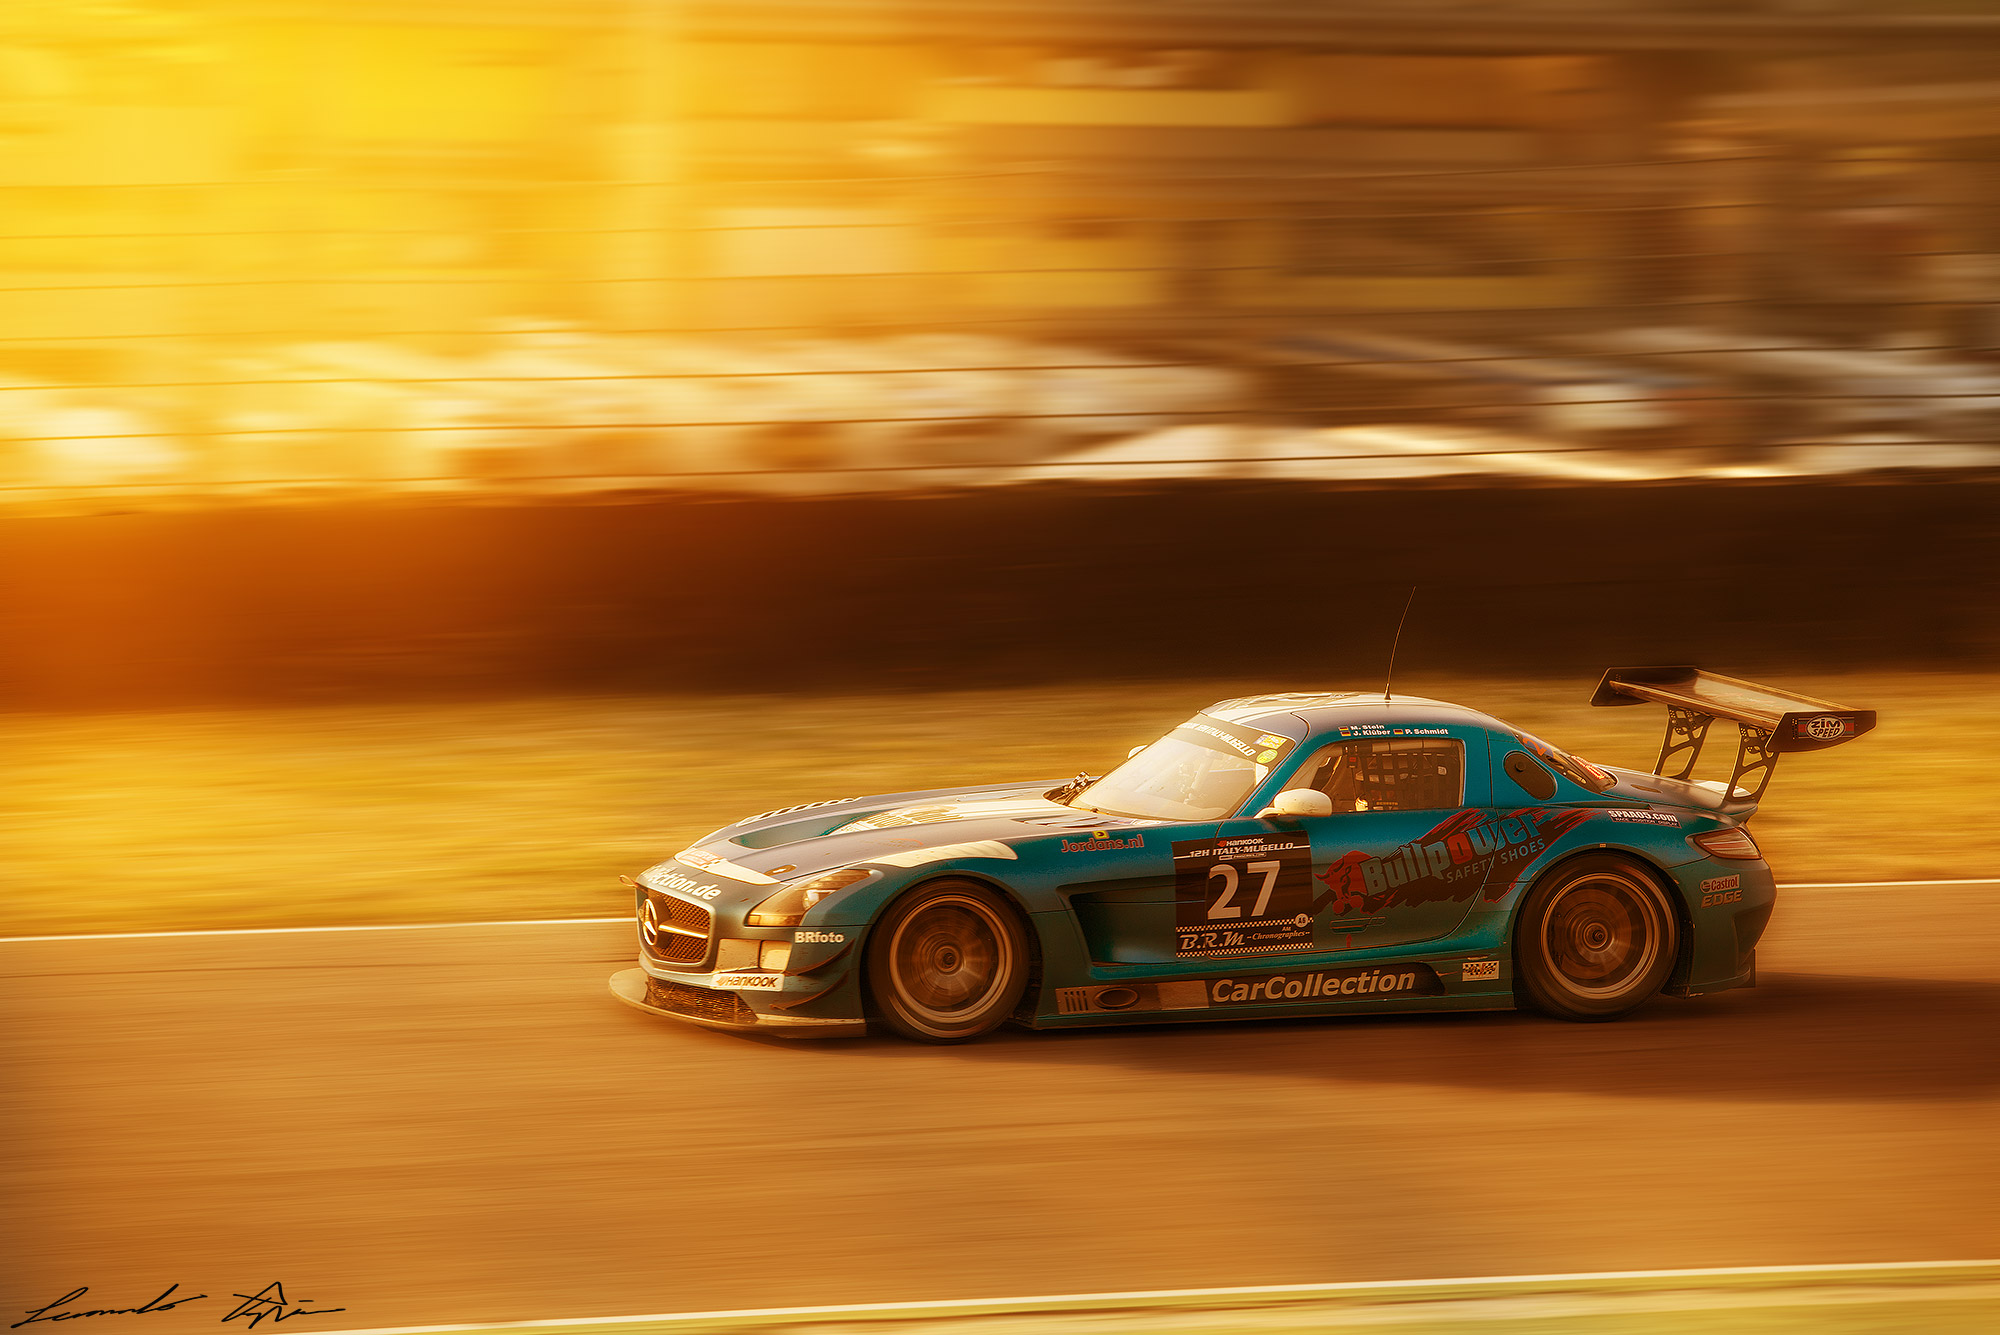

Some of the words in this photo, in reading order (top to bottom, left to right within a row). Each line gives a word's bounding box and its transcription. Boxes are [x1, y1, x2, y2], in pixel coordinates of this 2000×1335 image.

[1812, 728, 1840, 738] SPEED
[1061, 834, 1145, 853] Jordans.nl
[1190, 849, 1210, 858] 12H
[1213, 842, 1294, 857] ITALY-MUGELLO
[1359, 812, 1542, 897] Bullpower
[1446, 858, 1496, 884] SAFETY
[1501, 838, 1546, 865] SHOES
[1207, 860, 1281, 920] 27
[1710, 876, 1739, 891] Castrol
[1701, 890, 1744, 908] EDGE
[794, 931, 845, 944] BRfoto
[1212, 969, 1416, 1004] CarCollection
